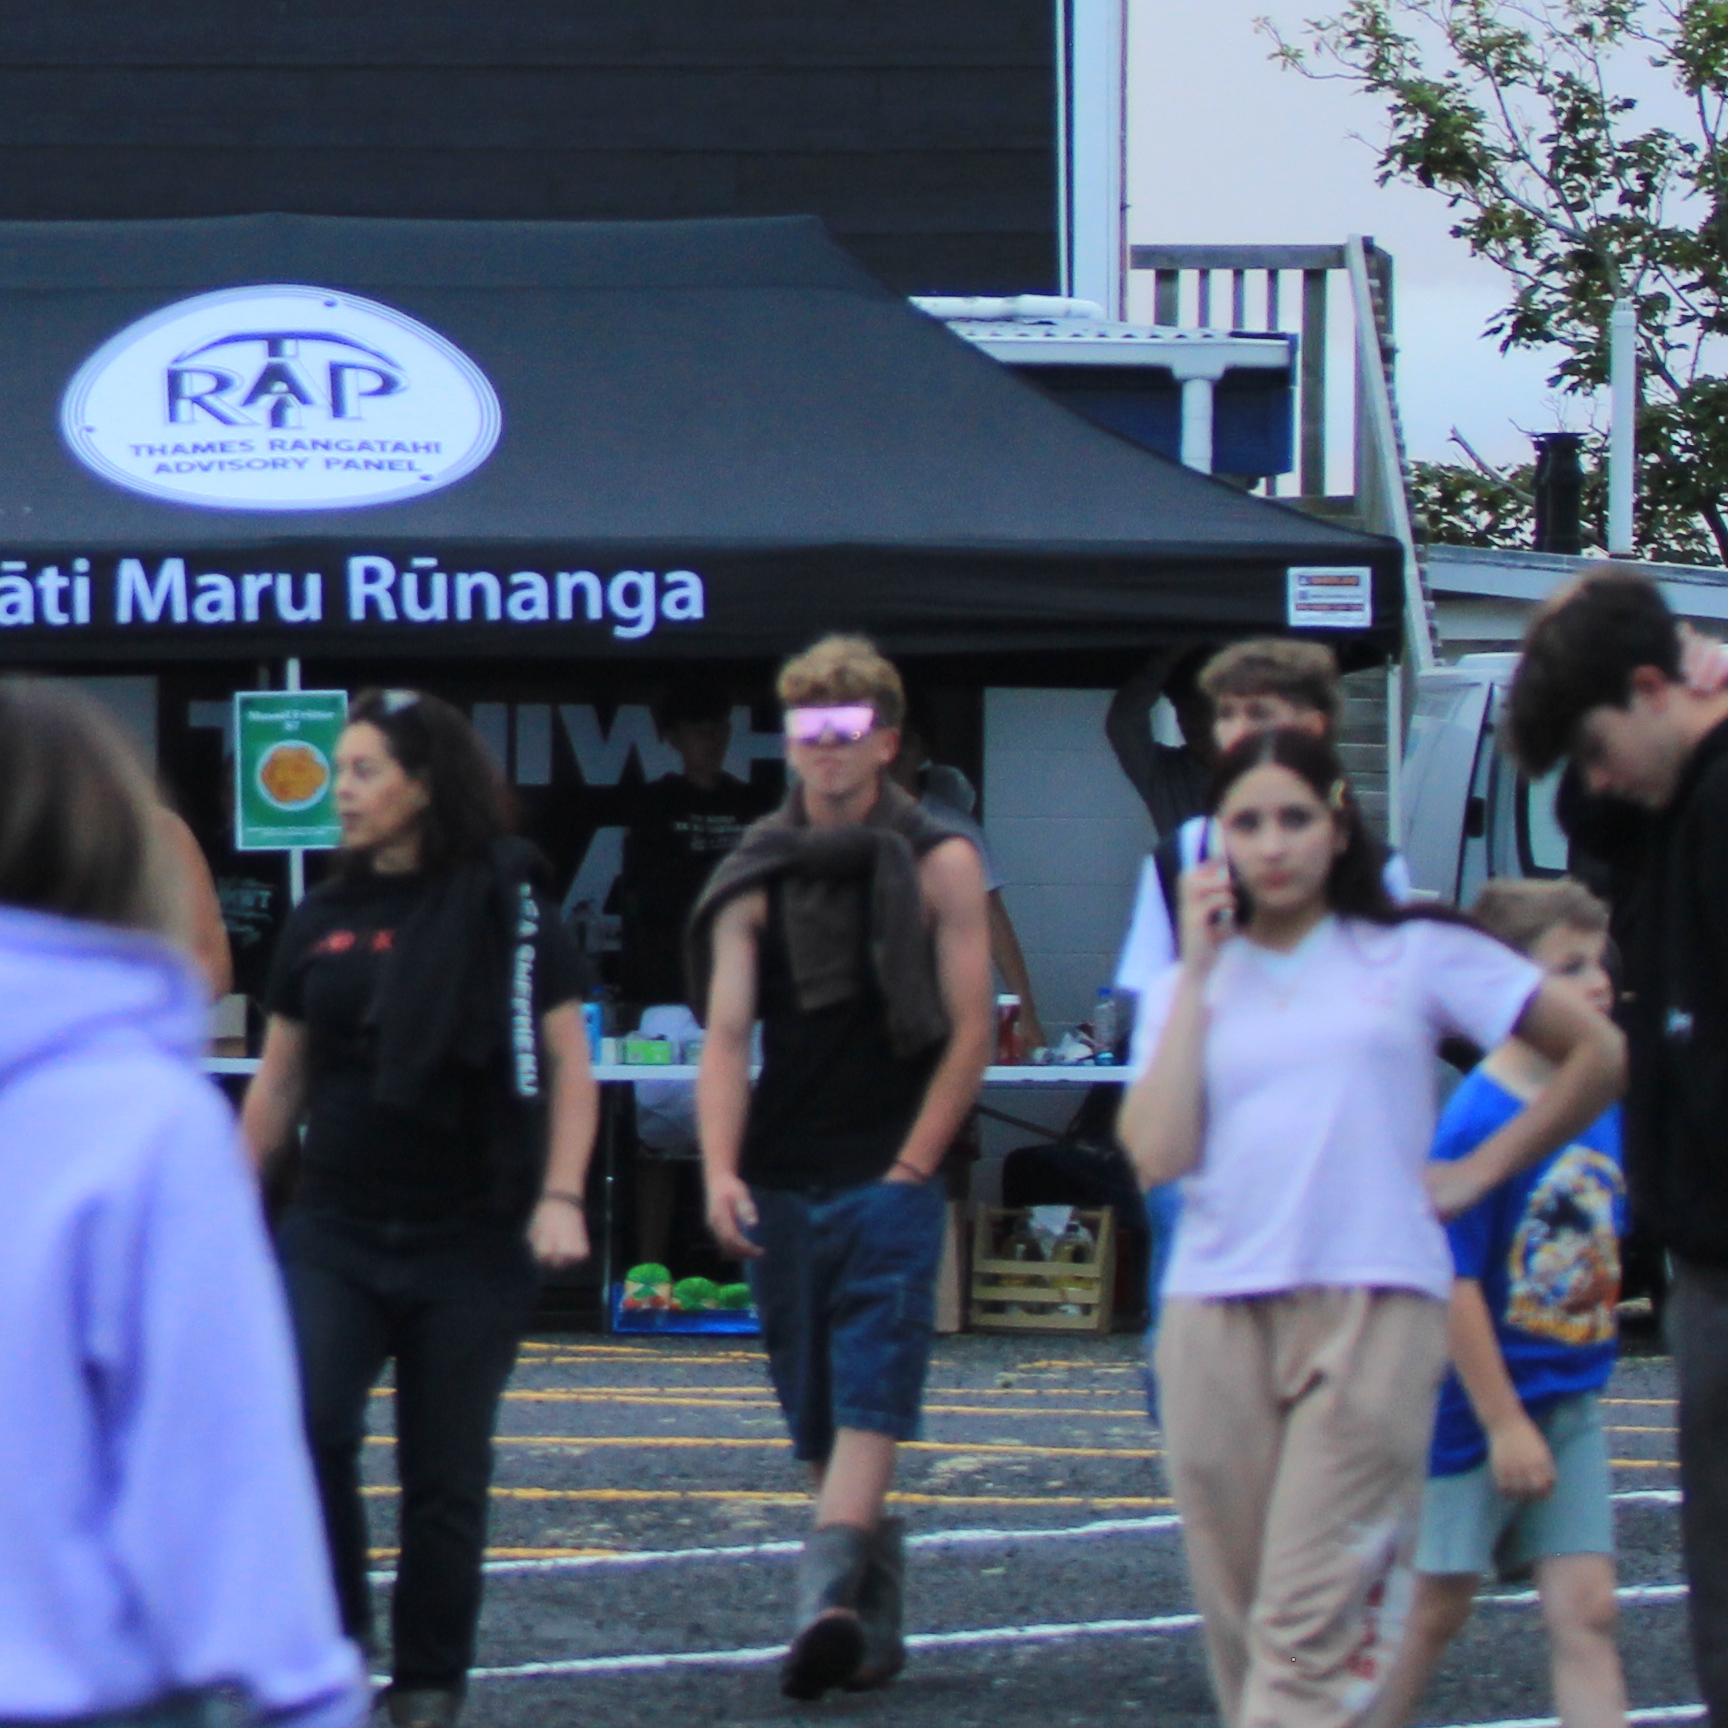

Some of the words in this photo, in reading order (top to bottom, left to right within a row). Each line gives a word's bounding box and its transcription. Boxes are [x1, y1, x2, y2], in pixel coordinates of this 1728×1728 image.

[128, 438, 255, 457] THAMES
[269, 438, 442, 455] RANGATAHI
[154, 457, 309, 474] ADVISORY
[324, 458, 424, 473] PANEL
[114, 557, 324, 624] Maru
[348, 554, 706, 638] Rūnanga
